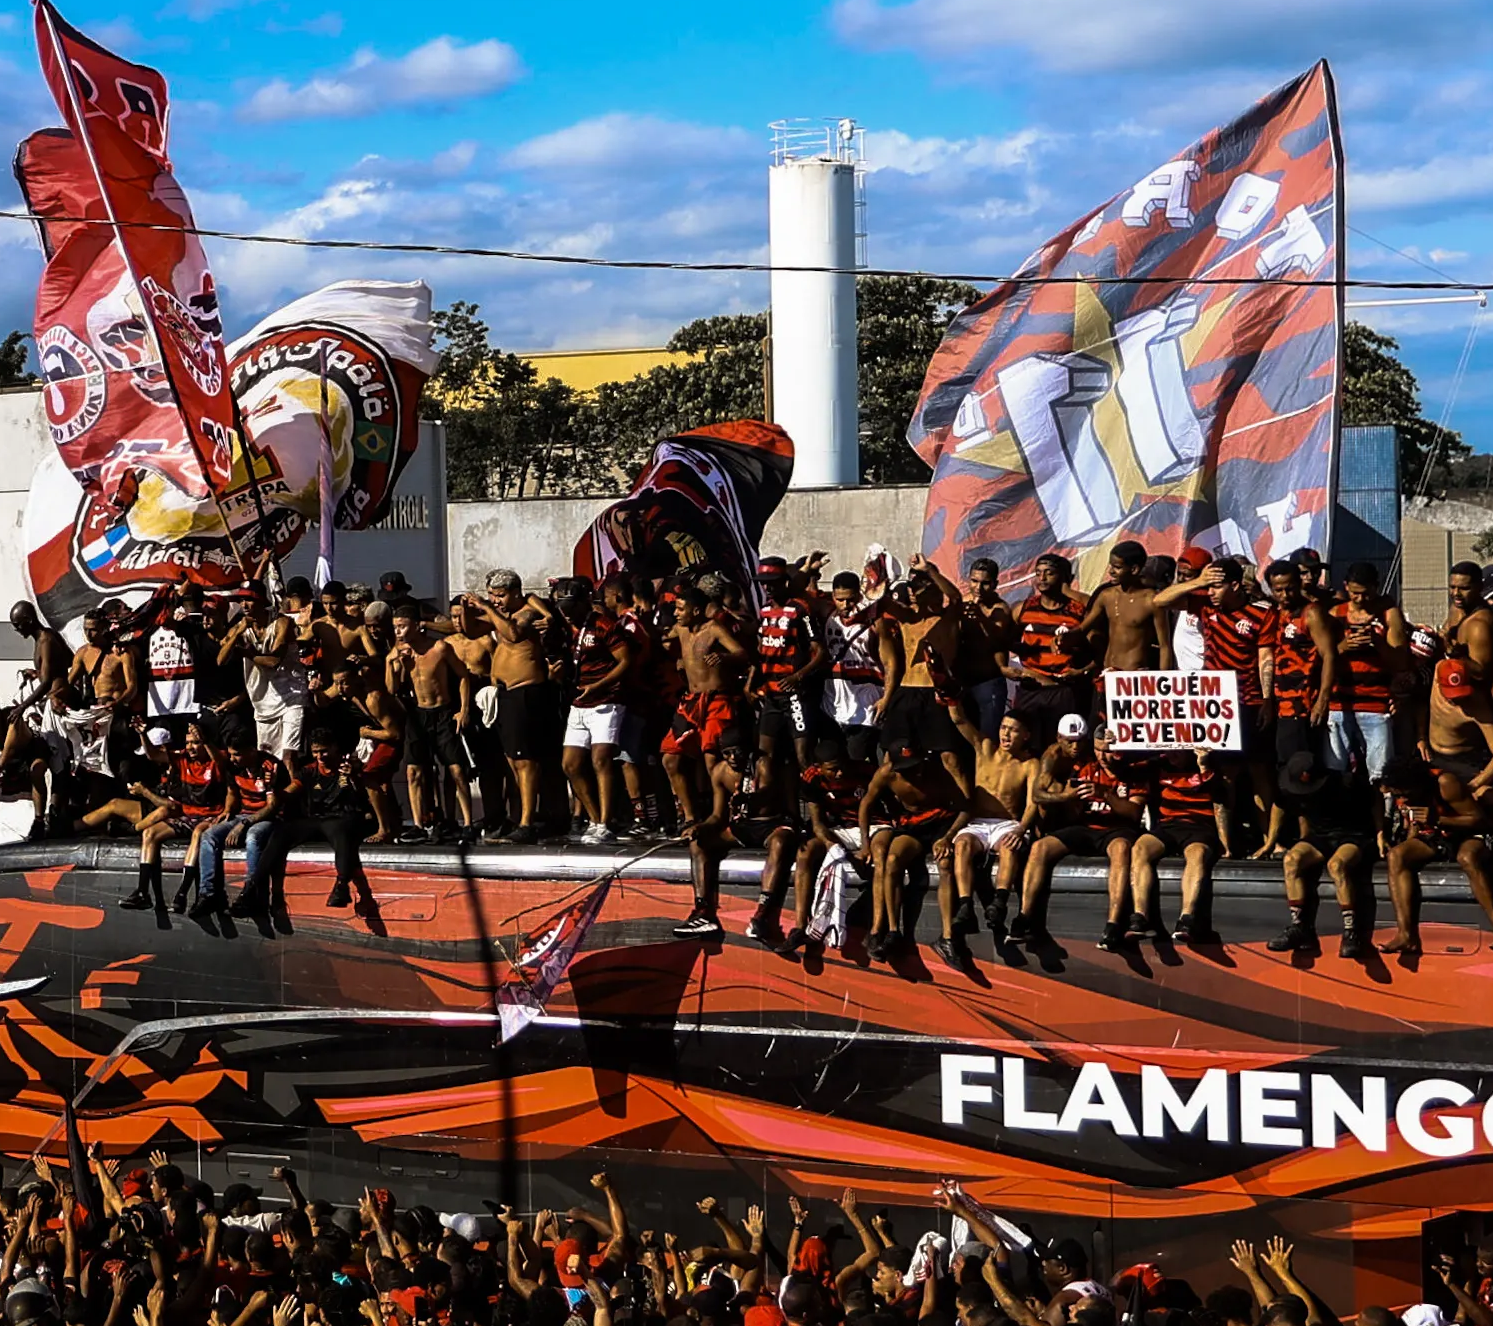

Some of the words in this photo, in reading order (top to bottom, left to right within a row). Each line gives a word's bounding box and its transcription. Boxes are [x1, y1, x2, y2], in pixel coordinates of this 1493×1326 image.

[1116, 673, 1221, 697] NINGUÉM
[1112, 700, 1185, 719] MORRE
[1192, 700, 1234, 720] NOS
[1118, 721, 1230, 749] DEVENDO!
